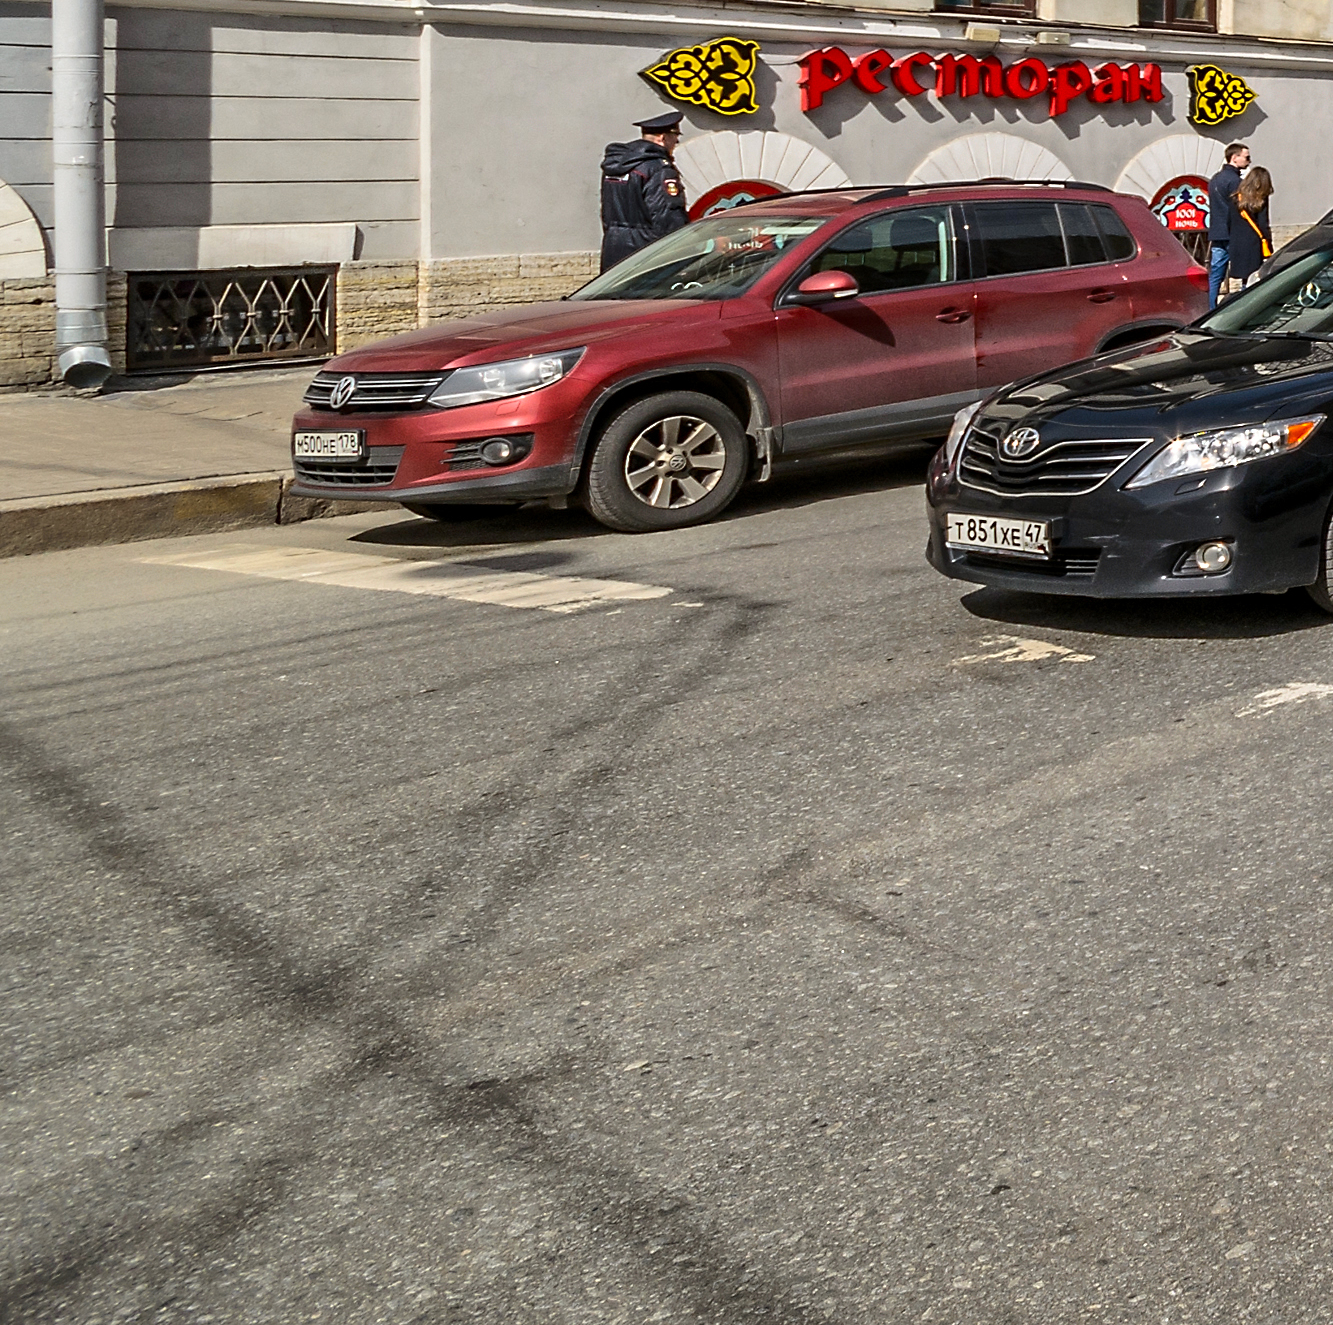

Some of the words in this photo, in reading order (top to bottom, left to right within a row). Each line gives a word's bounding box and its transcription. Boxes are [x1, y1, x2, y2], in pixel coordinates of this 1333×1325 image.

[797, 47, 1165, 117] ресторан
[1175, 208, 1196, 219] 1001
[297, 435, 336, 454] М500НЕ
[338, 434, 357, 448] 178
[955, 518, 1022, 547] Т851ХЕ
[1025, 523, 1042, 543] 47
